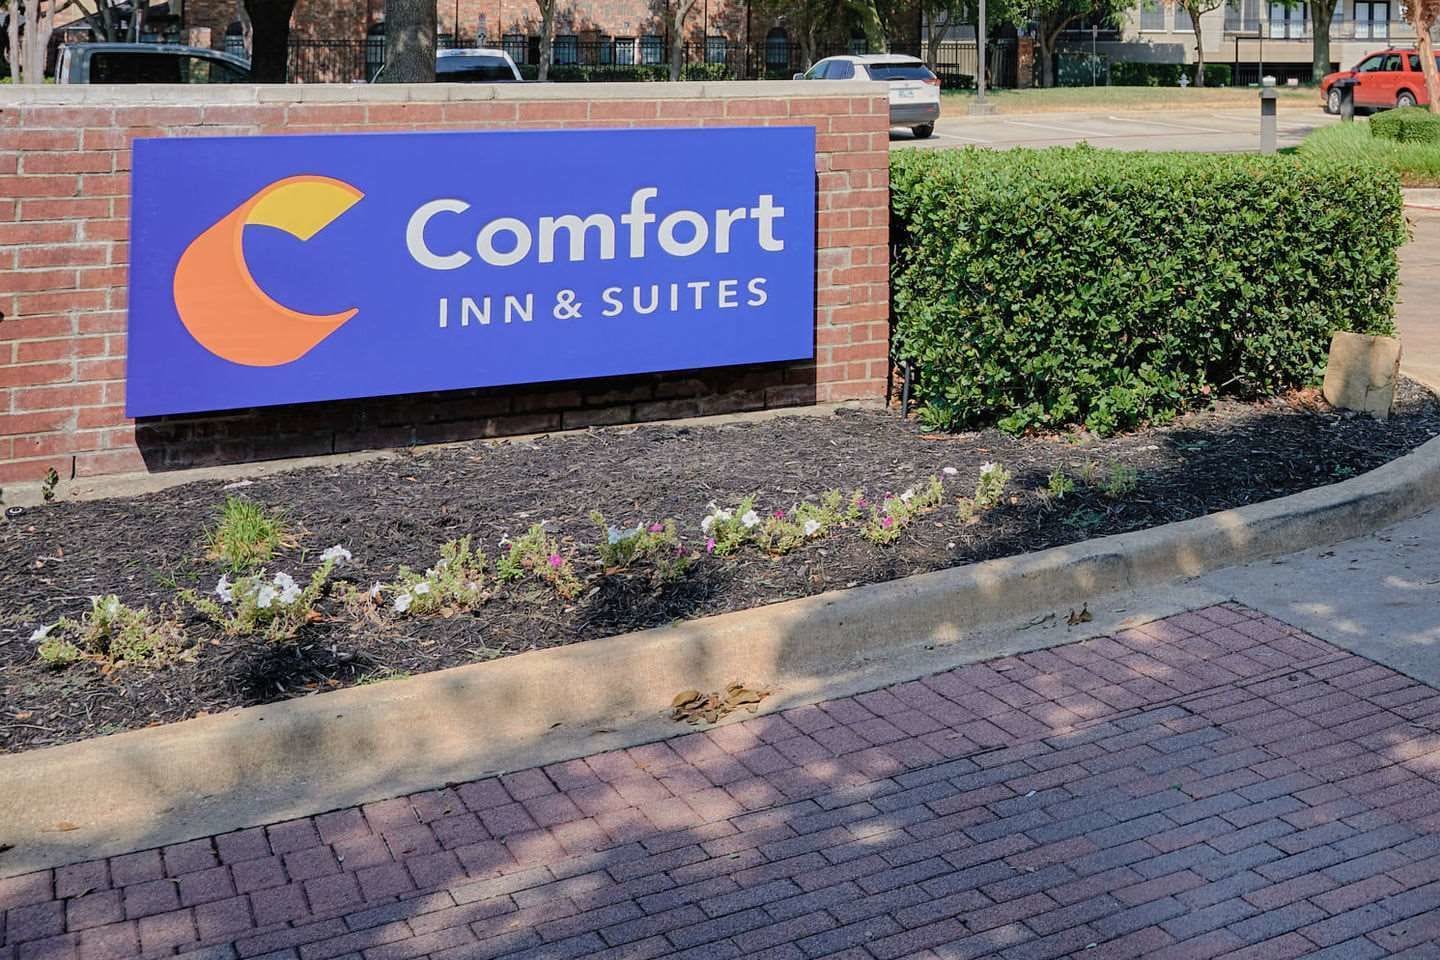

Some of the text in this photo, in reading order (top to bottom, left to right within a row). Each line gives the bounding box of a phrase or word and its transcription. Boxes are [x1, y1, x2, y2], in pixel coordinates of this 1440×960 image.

[405, 186, 786, 271] Comfort
[437, 276, 769, 329] INN & SUITES
